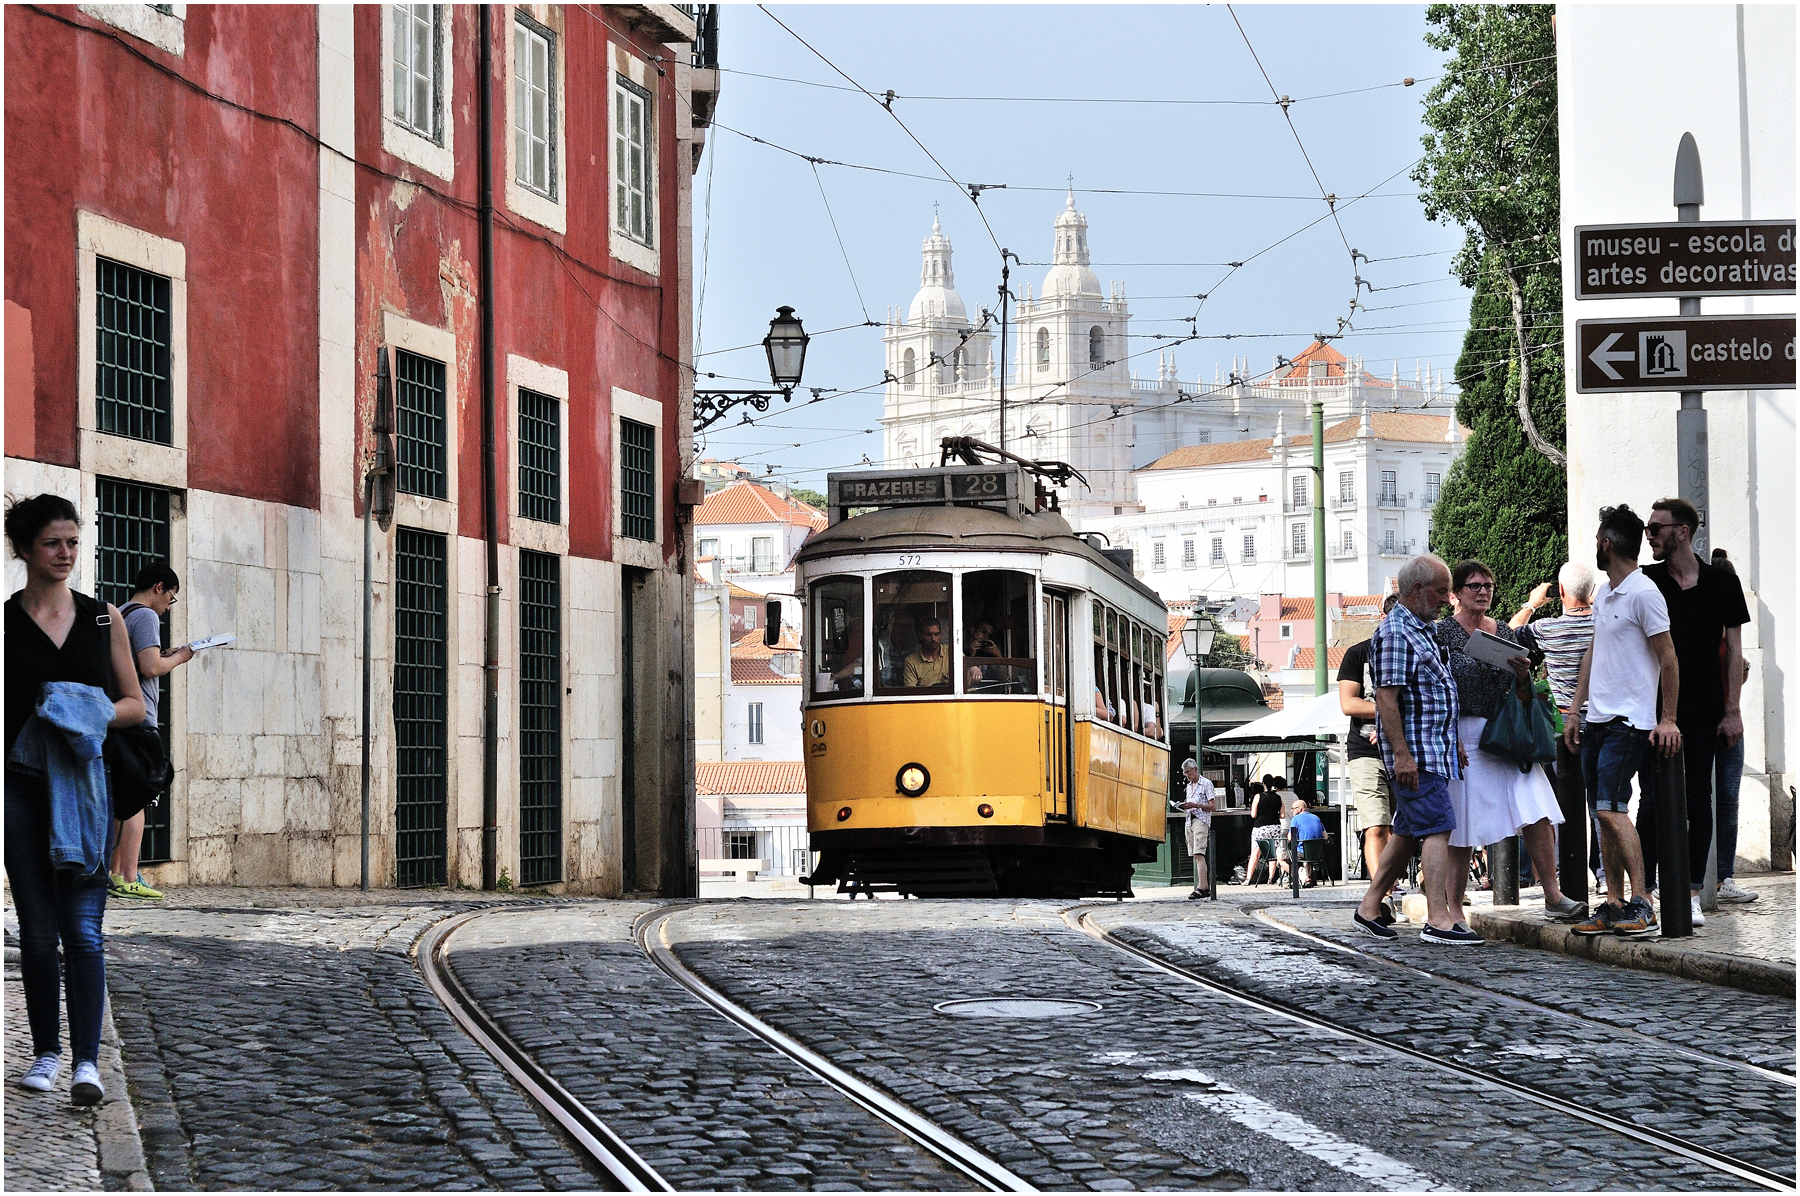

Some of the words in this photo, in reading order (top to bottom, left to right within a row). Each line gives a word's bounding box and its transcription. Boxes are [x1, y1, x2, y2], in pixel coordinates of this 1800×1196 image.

[1587, 236, 1661, 257] museu
[1688, 228, 1766, 253] escola
[1778, 228, 1796, 252] d
[1587, 262, 1647, 286] artes
[1660, 258, 1796, 284] decorativas
[1690, 337, 1773, 361] castelo
[842, 480, 937, 497] PRAZERES
[966, 474, 998, 493] 28
[899, 554, 921, 566] 572
